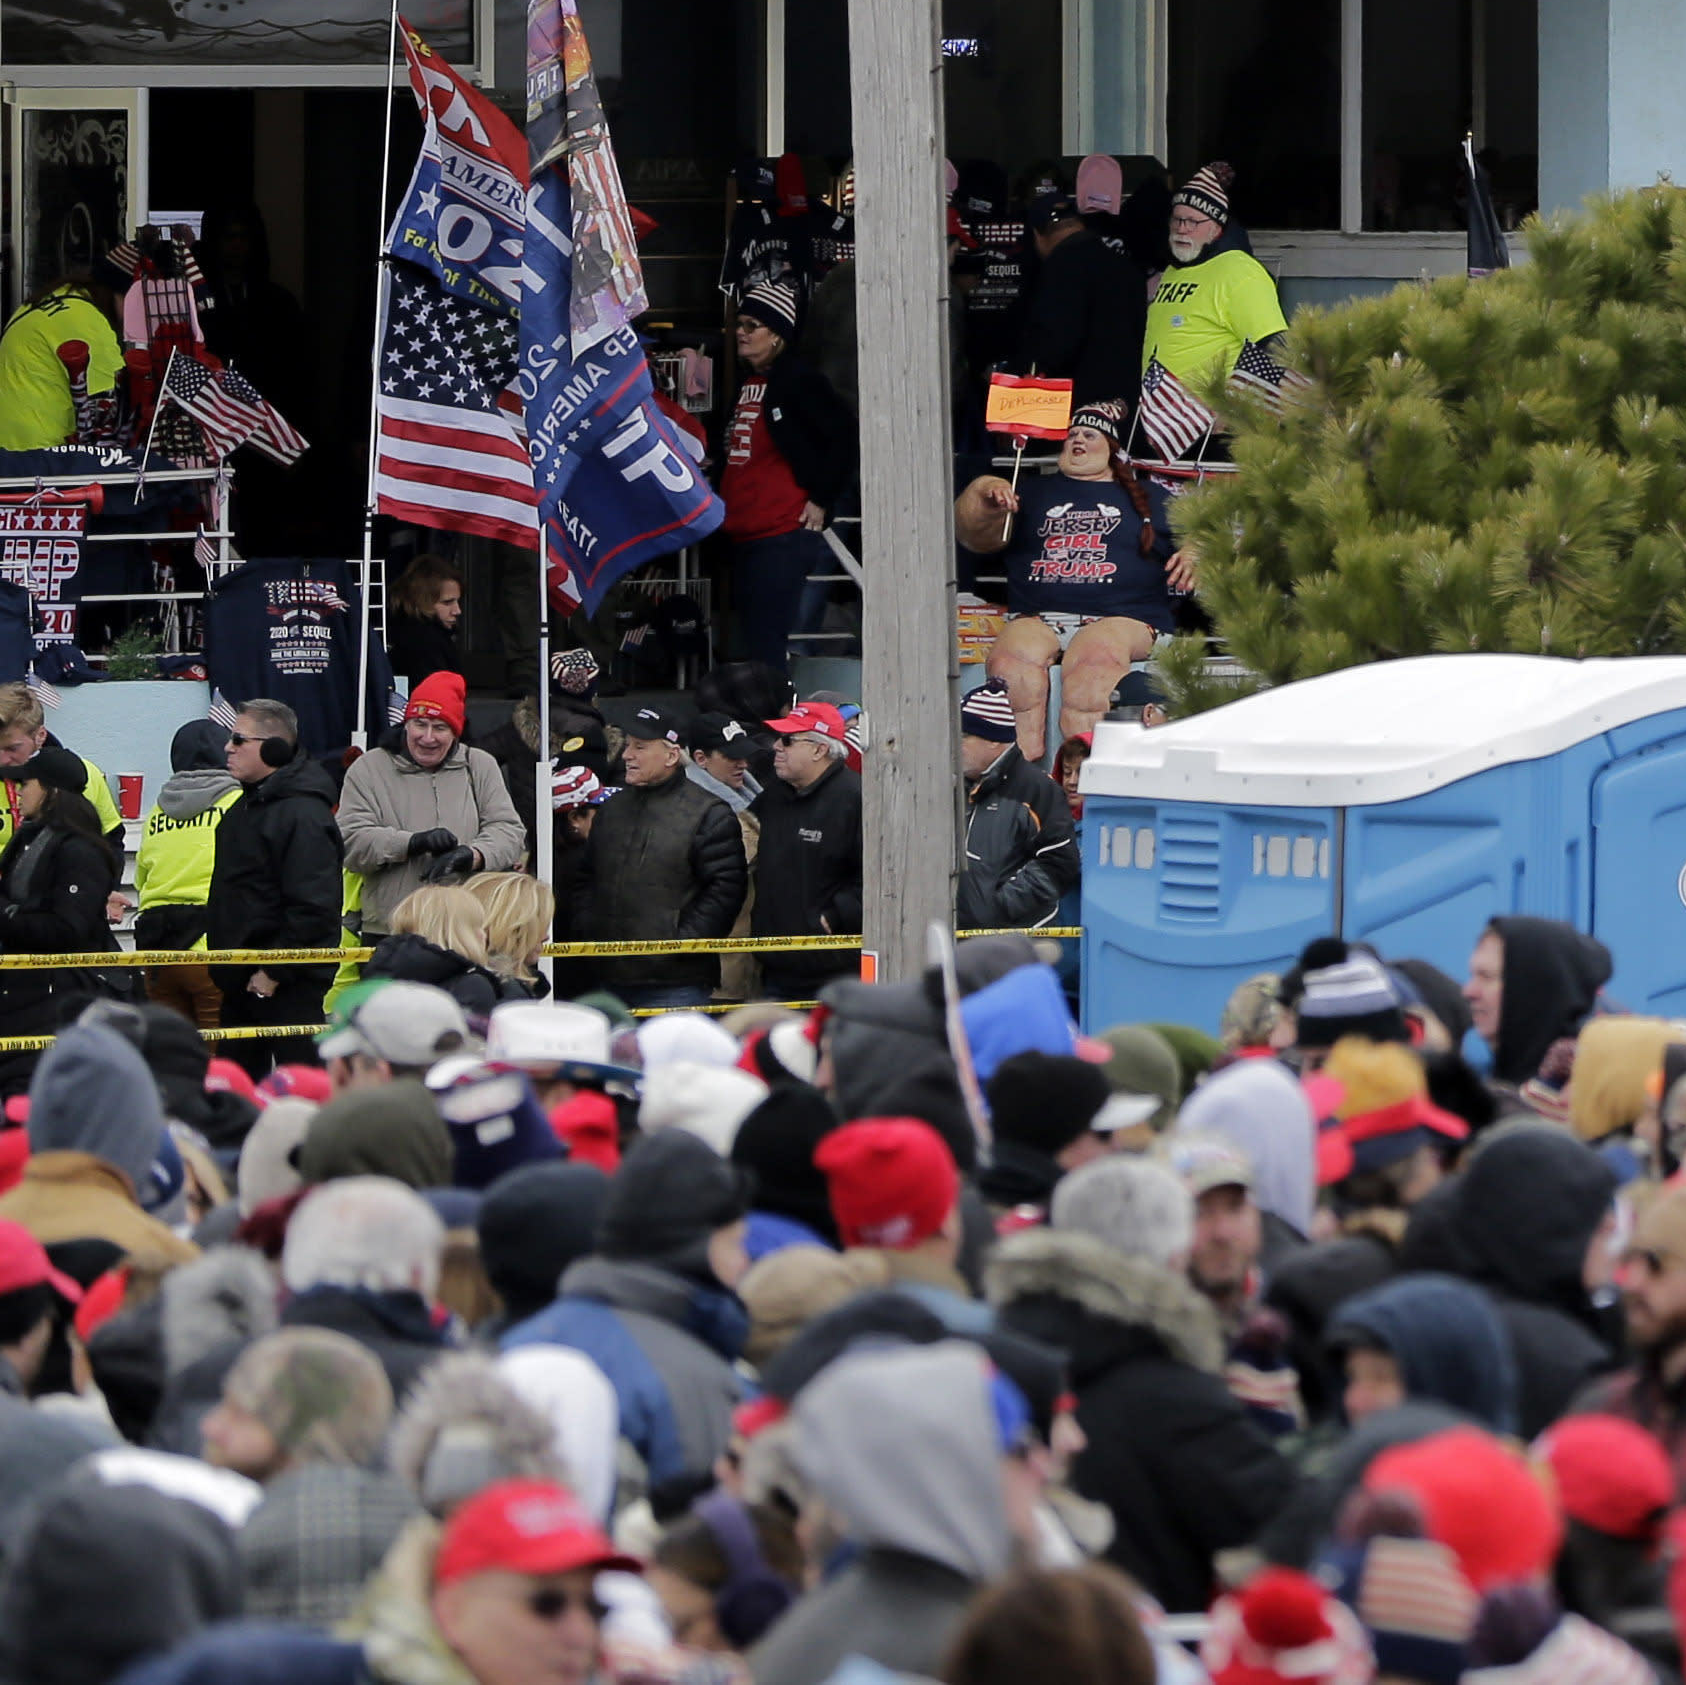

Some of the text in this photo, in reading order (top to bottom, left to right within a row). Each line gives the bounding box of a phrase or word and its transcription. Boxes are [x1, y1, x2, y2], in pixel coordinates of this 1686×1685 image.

[1191, 196, 1220, 218] MAKE
[1038, 517, 1121, 537] JERSEY
[1044, 533, 1106, 550] GIRL
[1030, 561, 1117, 578] TRUMP
